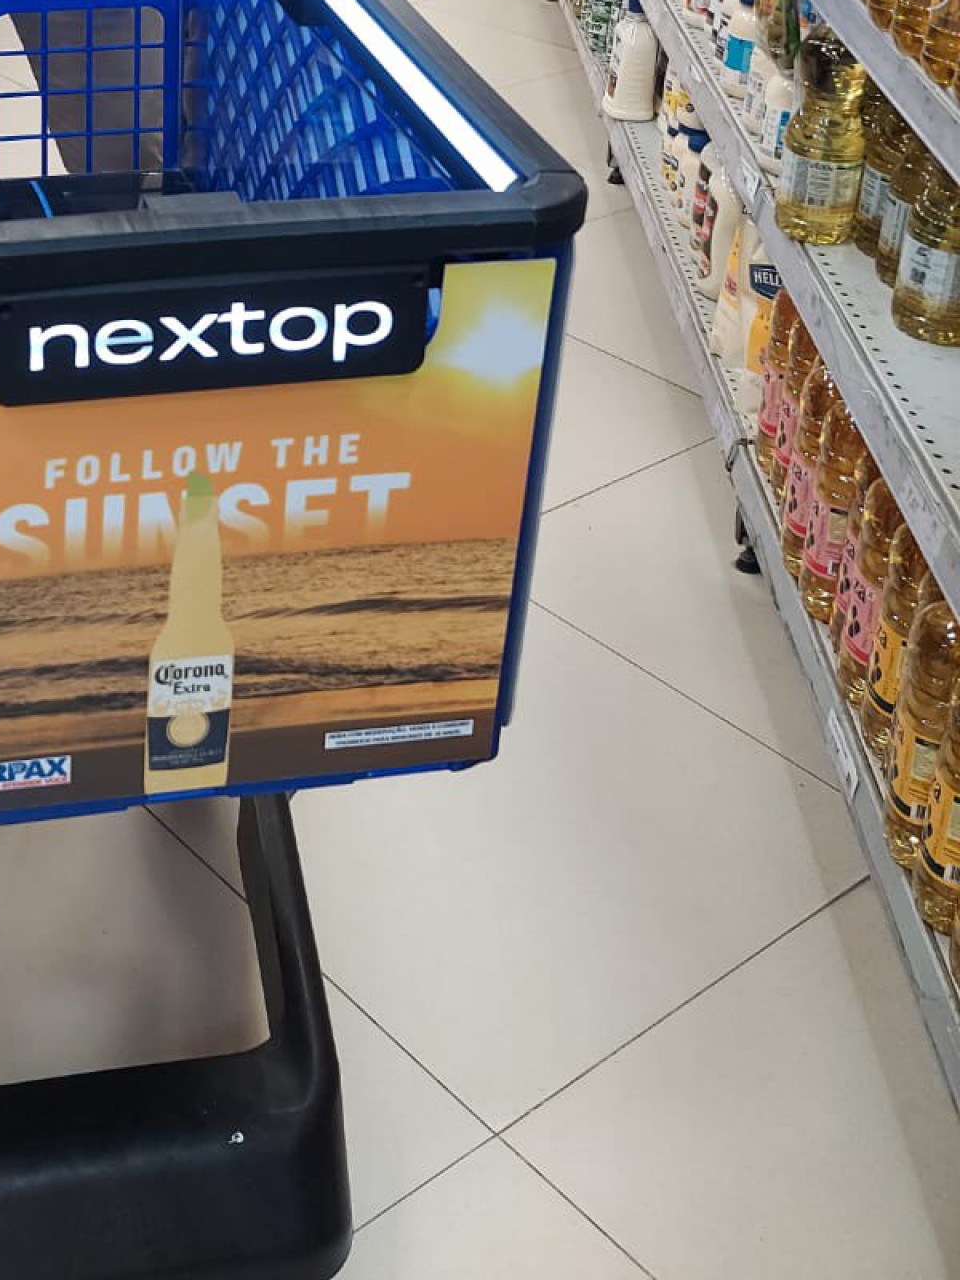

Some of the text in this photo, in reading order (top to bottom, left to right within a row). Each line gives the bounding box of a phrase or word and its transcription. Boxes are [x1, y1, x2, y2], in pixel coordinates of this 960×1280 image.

[29, 301, 393, 372] nextop
[44, 433, 361, 489] FOLLOW THE
[155, 663, 229, 686] Corona
[173, 681, 212, 696] Extra
